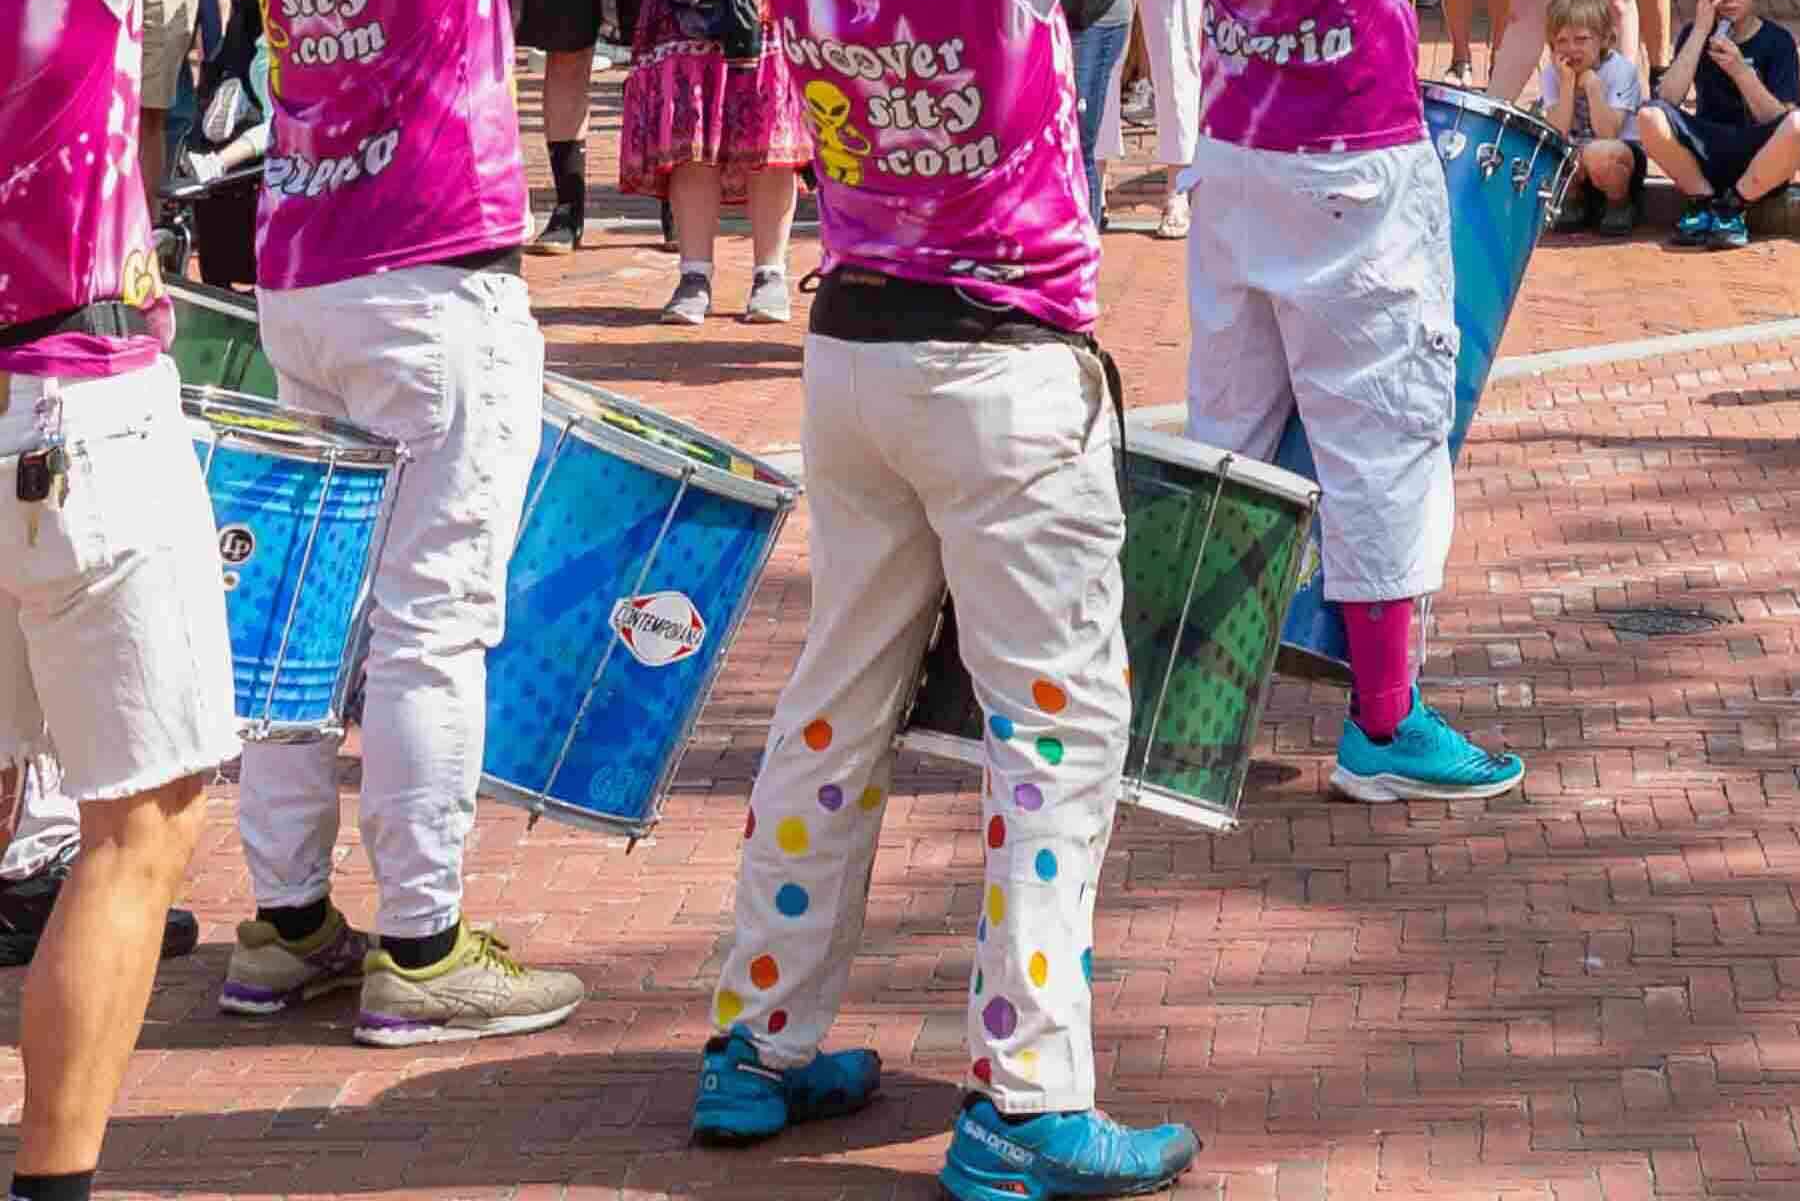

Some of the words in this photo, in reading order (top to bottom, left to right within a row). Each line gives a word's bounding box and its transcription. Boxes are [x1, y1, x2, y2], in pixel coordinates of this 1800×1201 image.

[290, 21, 386, 64] .com
[783, 15, 965, 81] Groover
[867, 85, 984, 134] sity
[876, 134, 1000, 177] .com
[961, 1118, 1034, 1170] SALOMON
